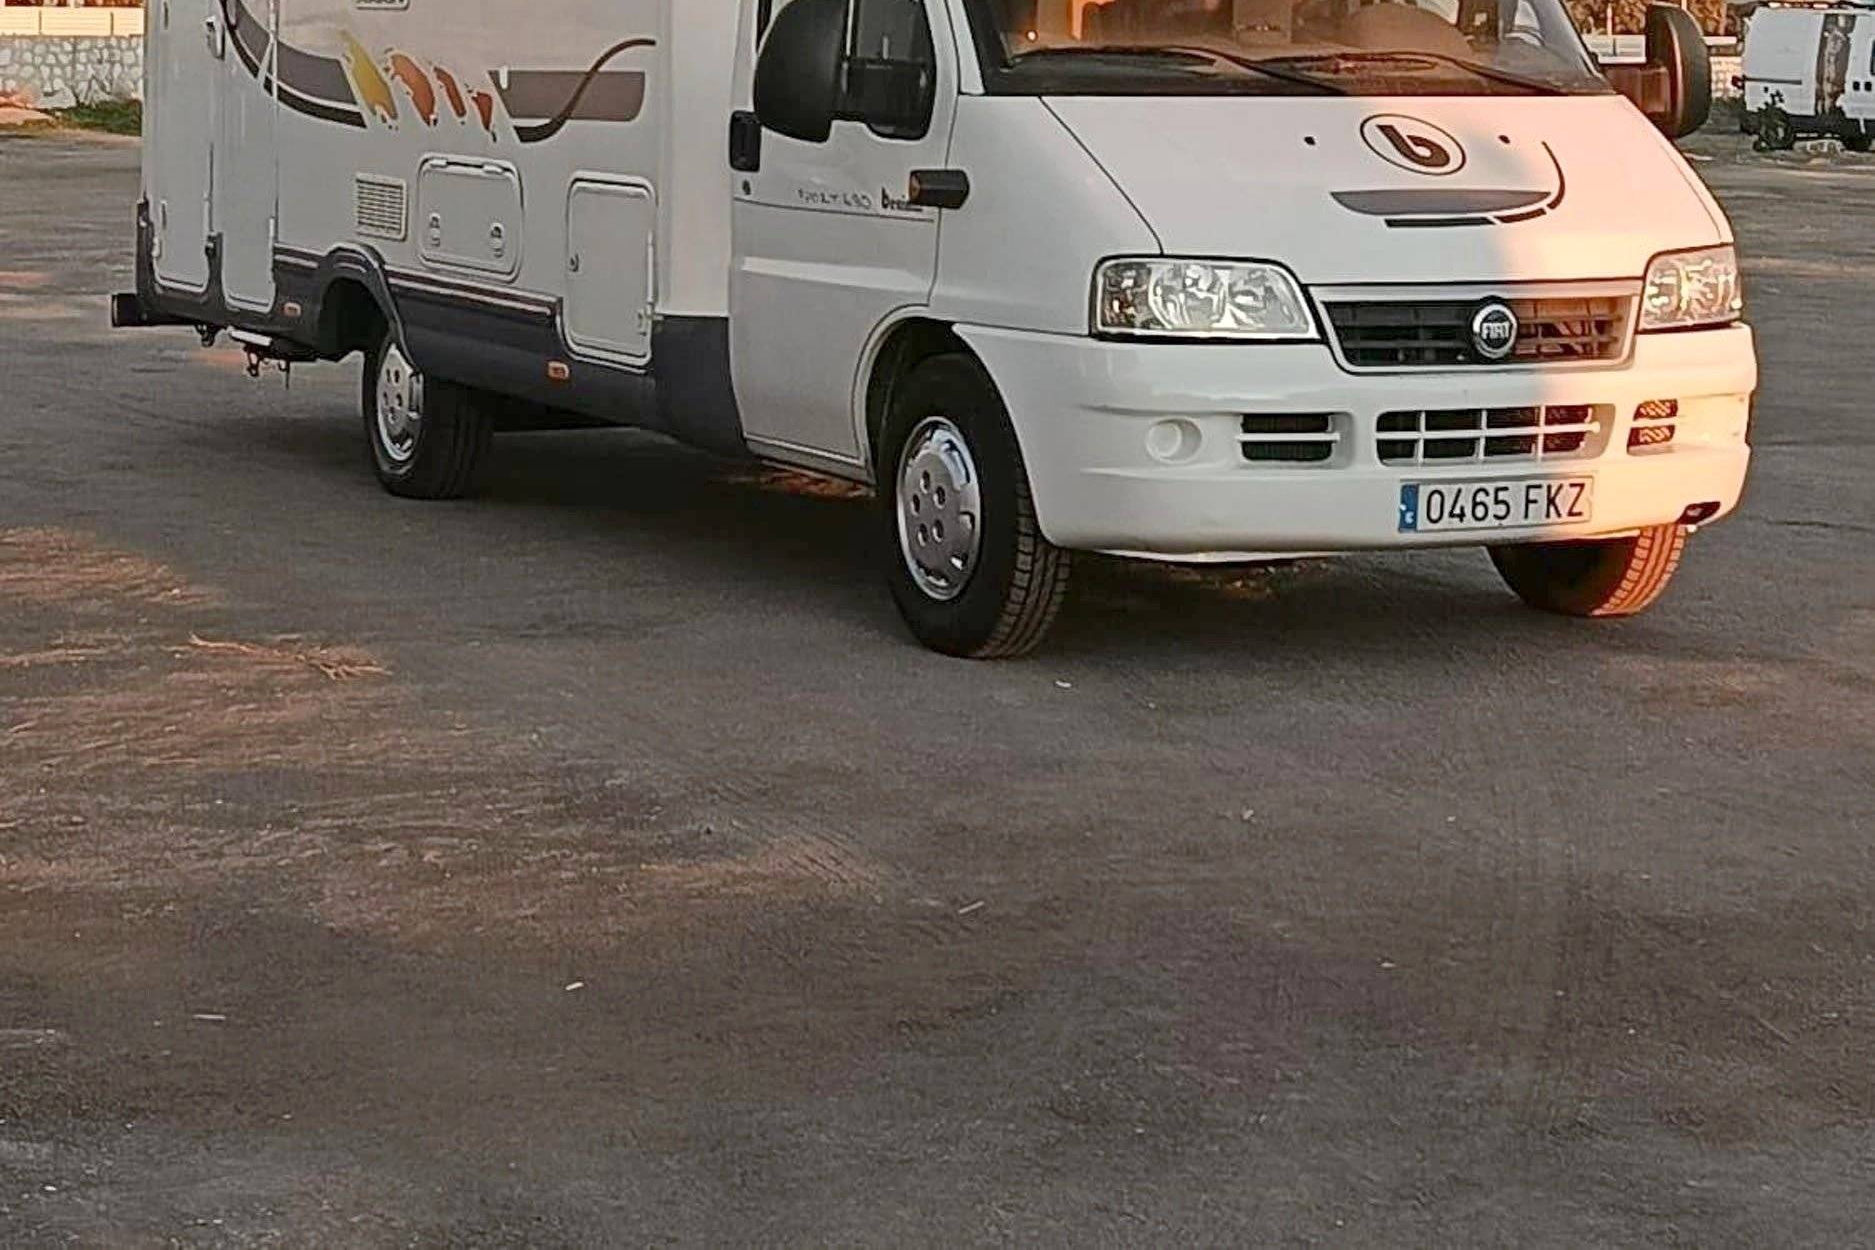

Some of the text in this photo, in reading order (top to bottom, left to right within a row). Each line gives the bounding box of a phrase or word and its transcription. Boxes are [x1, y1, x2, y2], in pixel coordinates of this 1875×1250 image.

[1376, 124, 1451, 167] b
[1481, 321, 1510, 340] FIAT
[1426, 482, 1586, 524] 0465 FKZ
